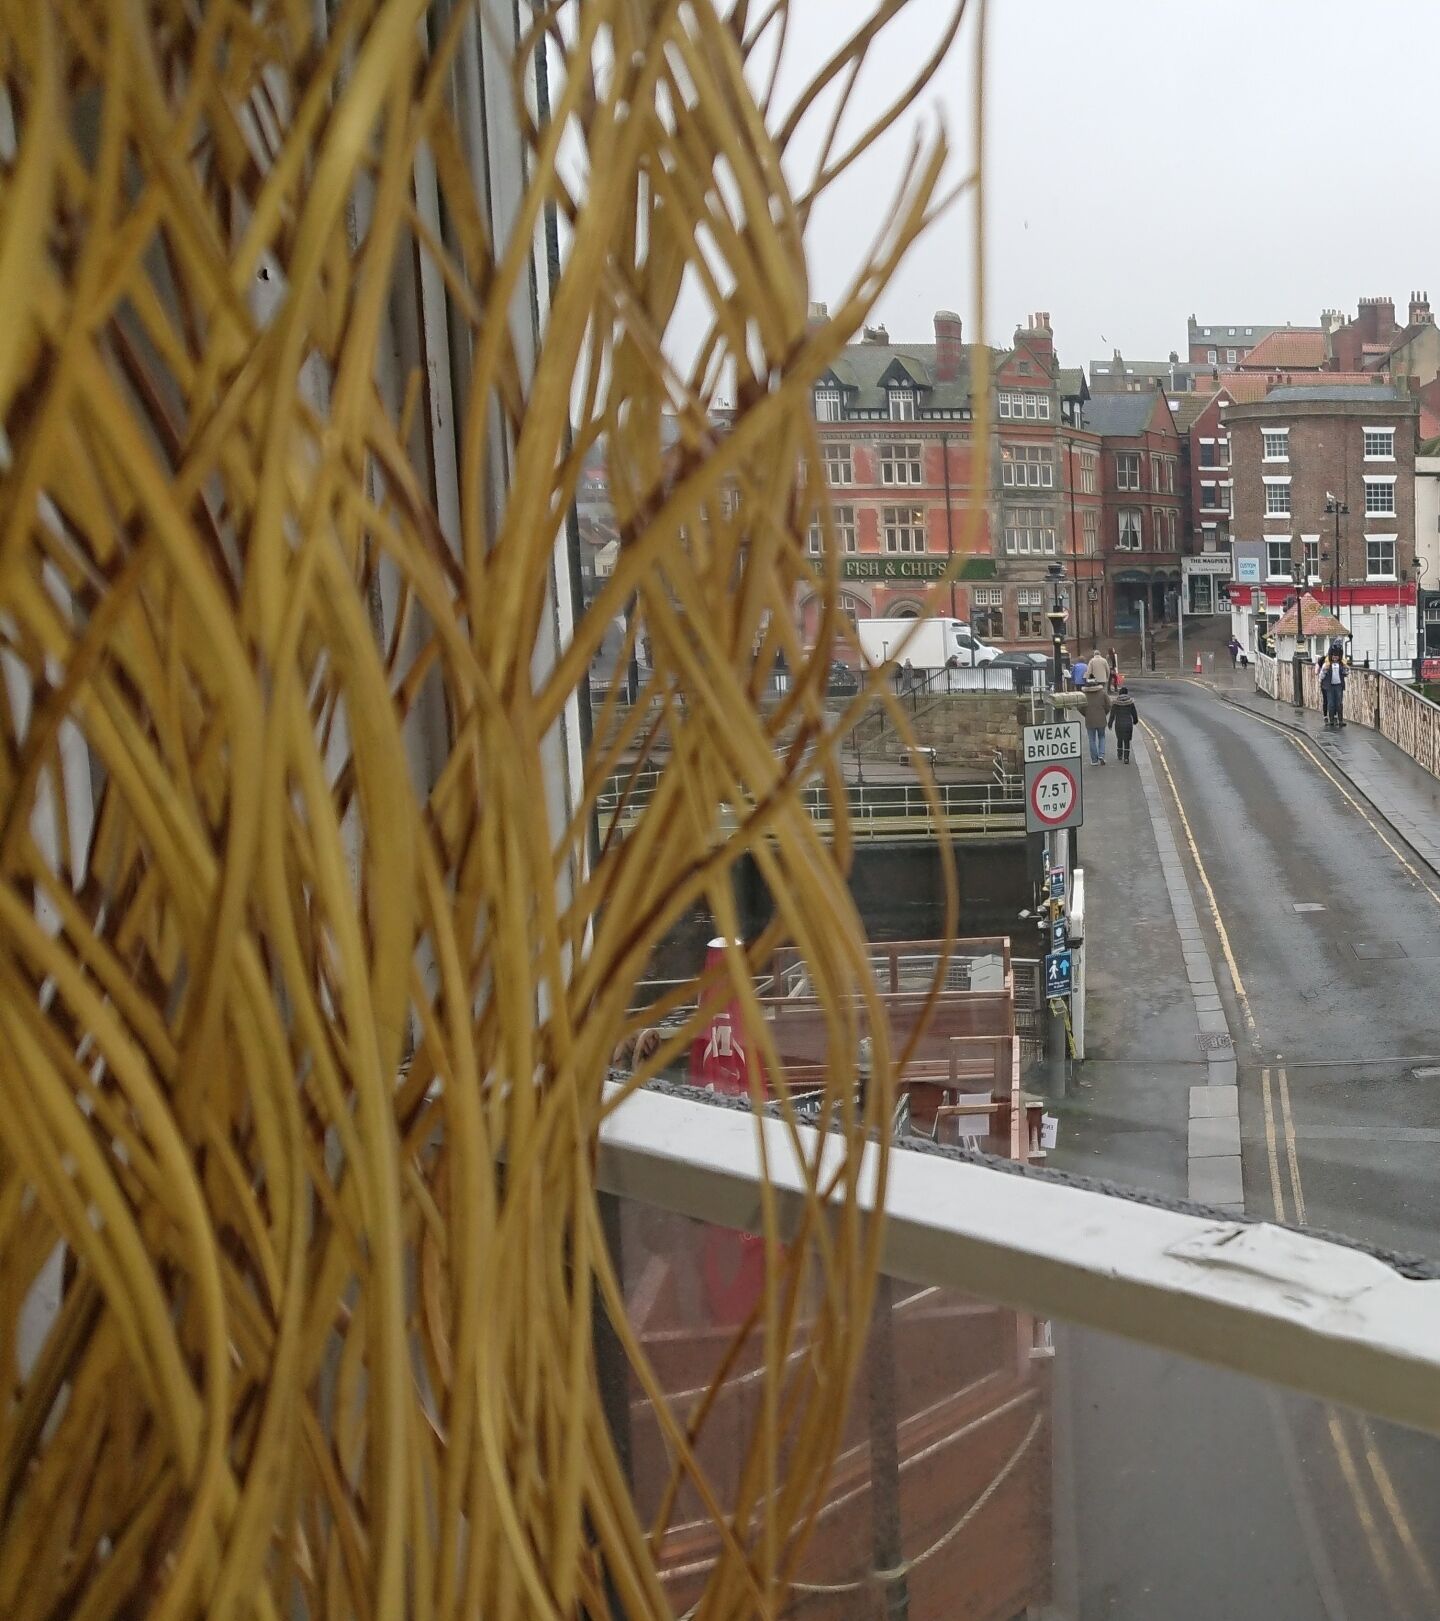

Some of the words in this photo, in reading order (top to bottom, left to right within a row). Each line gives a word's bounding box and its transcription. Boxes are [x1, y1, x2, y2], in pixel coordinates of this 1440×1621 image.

[846, 562, 879, 576] FISH
[884, 562, 896, 576] &
[901, 562, 947, 576] CHIPS
[1034, 726, 1071, 741] WEAK
[1028, 742, 1077, 758] BRIDGE
